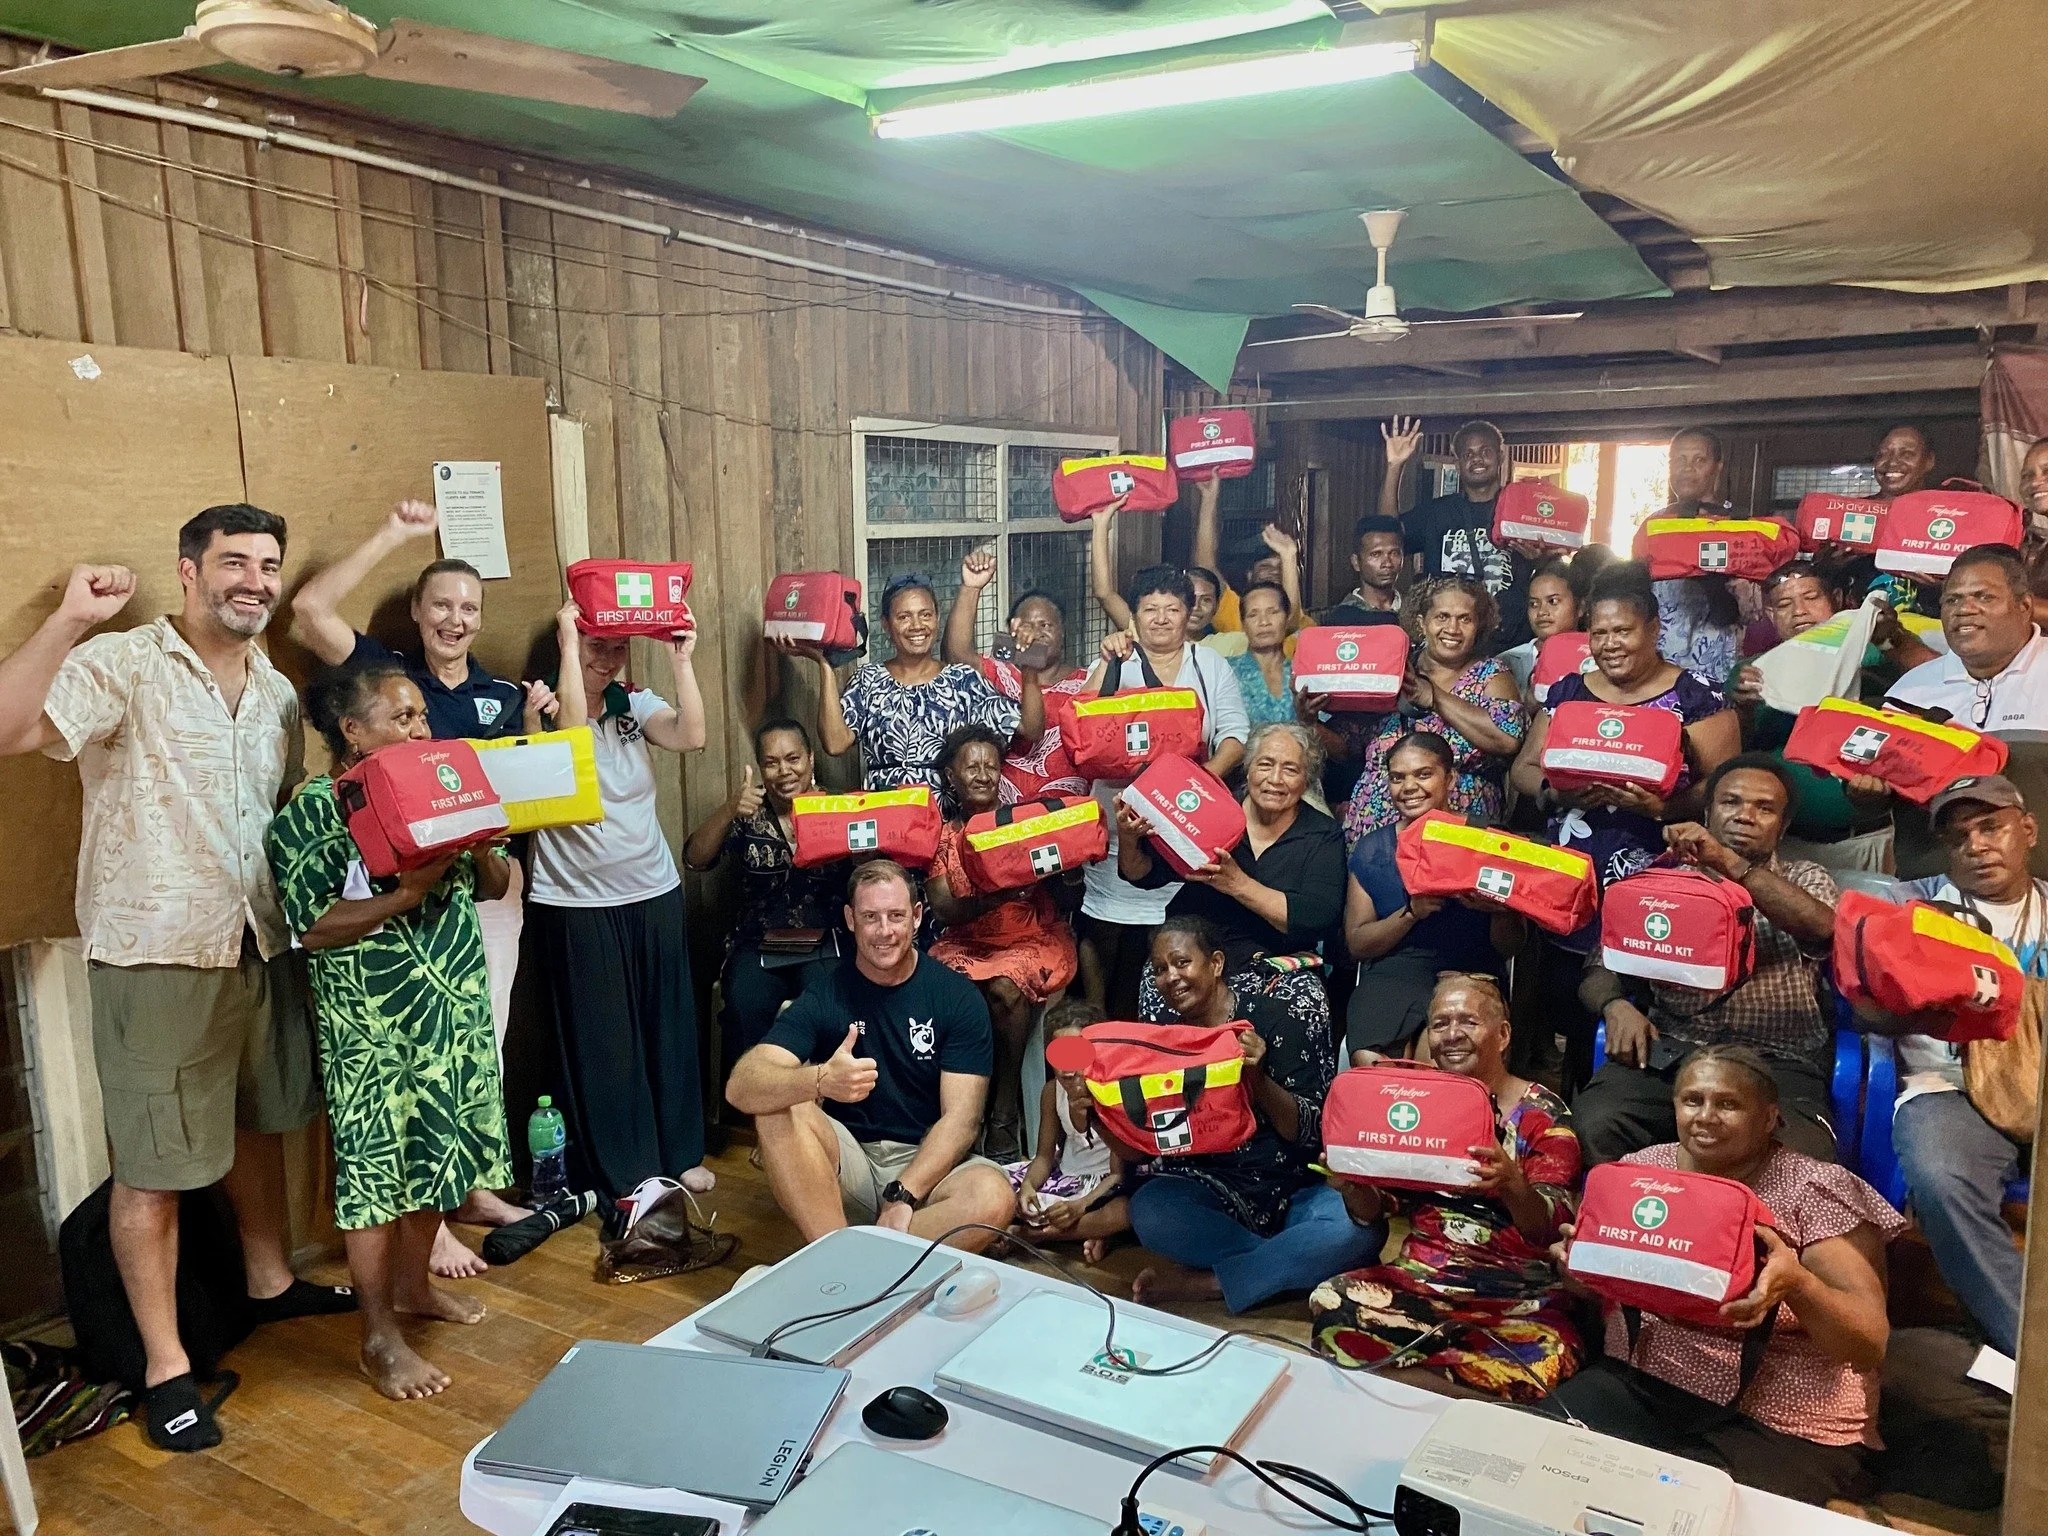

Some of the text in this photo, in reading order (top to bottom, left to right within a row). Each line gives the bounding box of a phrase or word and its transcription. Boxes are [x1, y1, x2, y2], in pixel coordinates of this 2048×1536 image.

[1190, 440, 1210, 449] FIRST
[1211, 438, 1223, 446] AID
[1826, 500, 1888, 515] RST AID KIT
[1521, 515, 1542, 523] FIRST
[1901, 538, 1931, 550] FIRST
[1932, 542, 1951, 551] AID
[596, 609, 674, 622] FIRST AID KIT
[1317, 663, 1377, 671] FIRST AID KIT
[1572, 737, 1644, 752] FIRST AID KIT
[431, 790, 486, 811] FIRST AID KIT
[1150, 788, 1201, 837] FIRST AID KIT
[1638, 896, 1680, 911] Trafalgar
[1623, 937, 1694, 957] FIRST AID KIT
[1379, 1083, 1430, 1100] Trafalgar
[1358, 1130, 1448, 1149] FIRST AID KIT
[1630, 1177, 1685, 1194] Trafalgar
[1598, 1225, 1694, 1252] FIRST AID KIT
[759, 1439, 797, 1487] LEGION
[1541, 1464, 1590, 1484] EPSON
